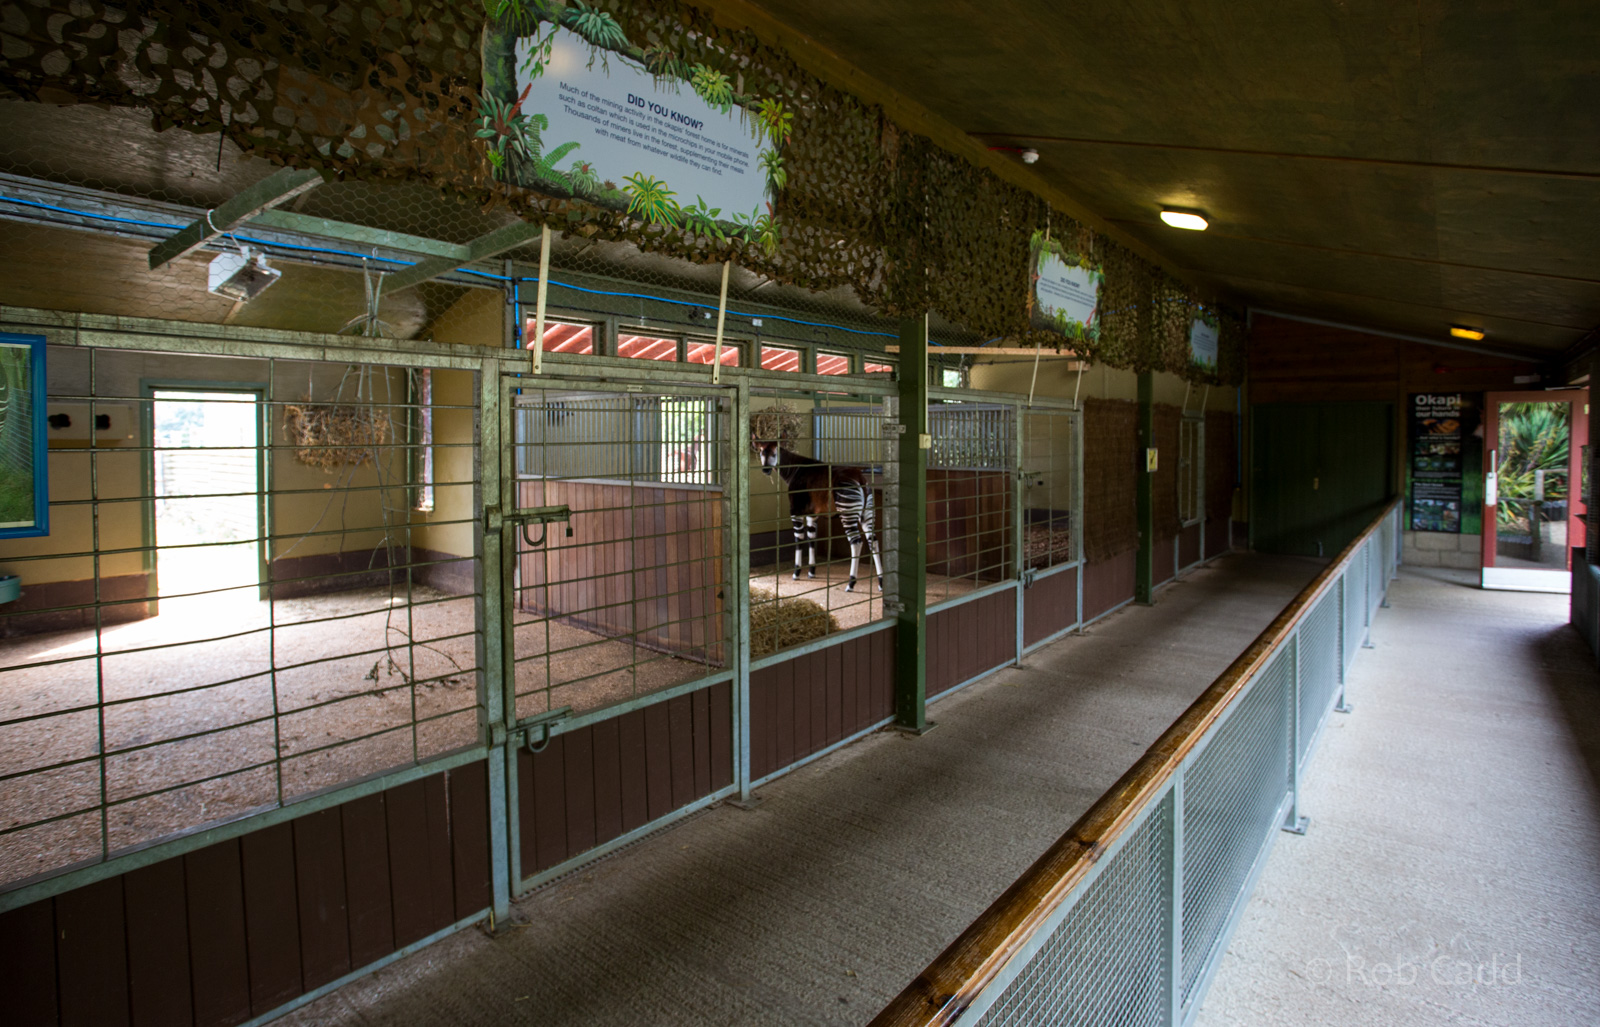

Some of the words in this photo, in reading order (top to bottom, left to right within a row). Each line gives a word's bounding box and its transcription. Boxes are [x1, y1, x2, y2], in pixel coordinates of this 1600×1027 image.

[559, 94, 576, 104] such
[587, 103, 608, 116] coltan
[609, 111, 628, 122] which
[629, 118, 634, 126] is
[636, 120, 650, 131] used
[658, 128, 668, 138] the
[668, 132, 698, 149] microchips
[704, 146, 716, 156] your
[716, 150, 732, 162] mobile
[734, 157, 750, 168] phone.
[560, 82, 579, 95] Much
[602, 98, 623, 112] mining
[624, 107, 646, 120] activity
[654, 116, 663, 126] the
[685, 129, 700, 139] forest
[701, 136, 716, 146] home
[730, 146, 749, 158] minerals
[564, 104, 600, 124] Thousands
[610, 122, 632, 134] miners
[633, 129, 643, 138] live
[651, 136, 660, 144] the
[662, 140, 678, 152] forest,
[680, 146, 718, 166] supplementing
[718, 160, 730, 169] their
[628, 93, 646, 108] DID
[648, 101, 668, 117] YOU
[670, 110, 704, 130] KNOW?
[594, 128, 608, 137] with
[610, 132, 626, 143] meat
[628, 138, 641, 148] from
[642, 142, 668, 156] whatever
[670, 152, 688, 164] wildlife
[690, 158, 700, 170] they
[712, 166, 722, 176] find.
[1415, 394, 1460, 406] Okapi
